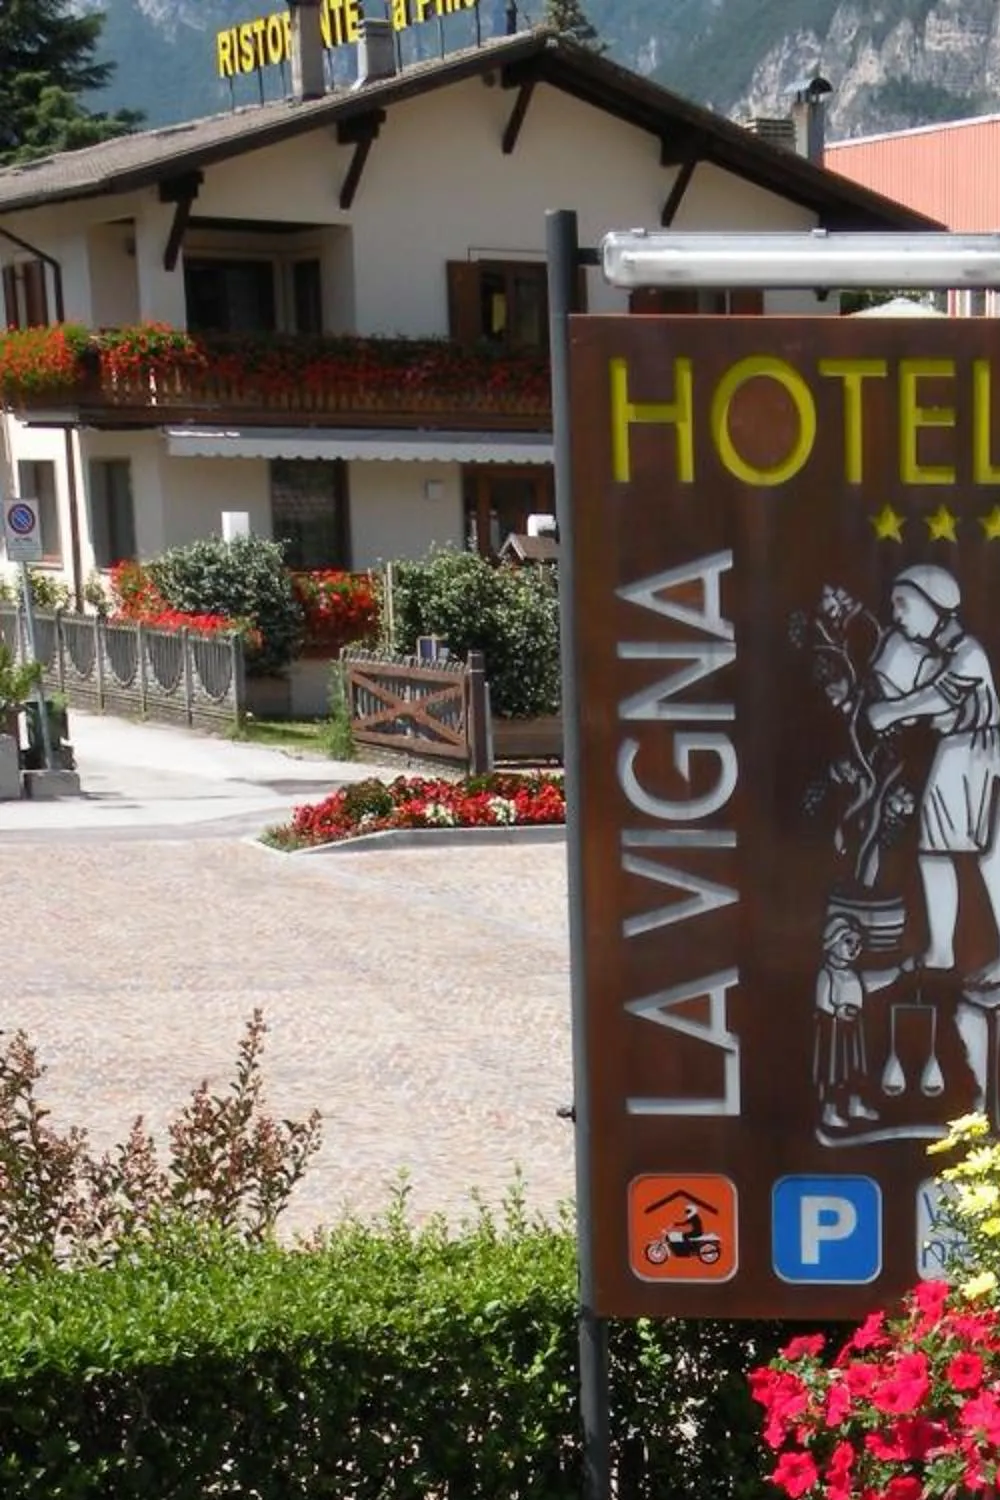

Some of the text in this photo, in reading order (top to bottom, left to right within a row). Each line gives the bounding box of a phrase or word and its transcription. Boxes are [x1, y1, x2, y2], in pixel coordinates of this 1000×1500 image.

[217, 0, 358, 78] RISTORNTE
[615, 548, 740, 1116] LA VIGNA
[801, 1196, 857, 1264] P
